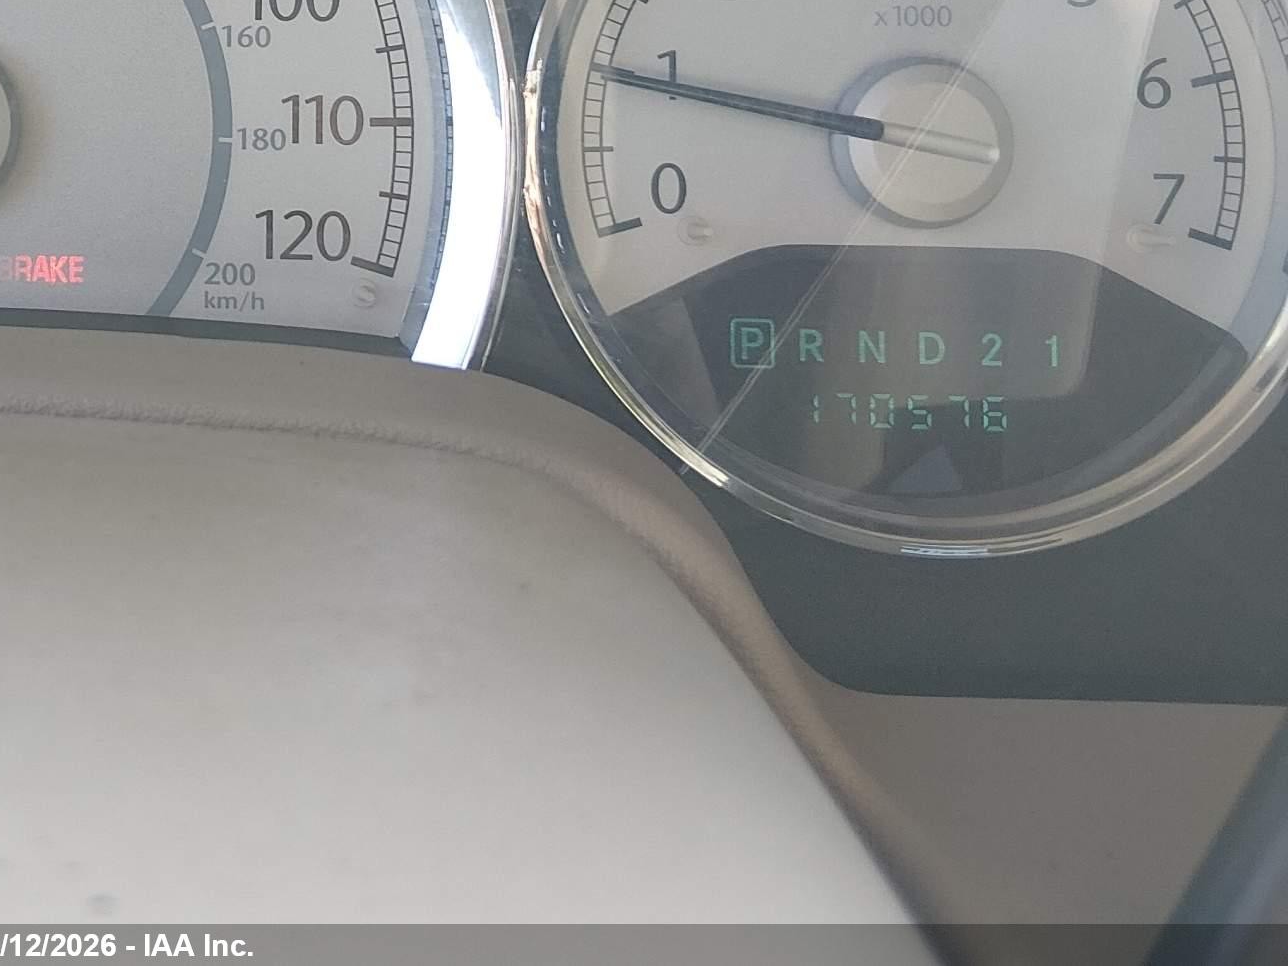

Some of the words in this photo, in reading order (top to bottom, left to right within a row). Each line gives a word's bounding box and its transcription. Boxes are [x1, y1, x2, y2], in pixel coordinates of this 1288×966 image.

[222, 25, 271, 48] 160
[657, 49, 677, 100] 1
[1137, 58, 1172, 109] 6
[237, 128, 286, 151] 180
[282, 94, 365, 146] 110
[651, 162, 688, 215] 0
[1153, 174, 1186, 225] 7
[255, 210, 352, 262] 120
[204, 262, 256, 286] 200
[204, 290, 265, 312] km/h
[740, 327, 765, 360] P
[799, 329, 824, 362] R
[858, 330, 886, 364] N
[918, 332, 946, 366] D
[981, 333, 1003, 367] 2
[1045, 335, 1060, 368] 1
[813, 393, 1008, 432] 170576
